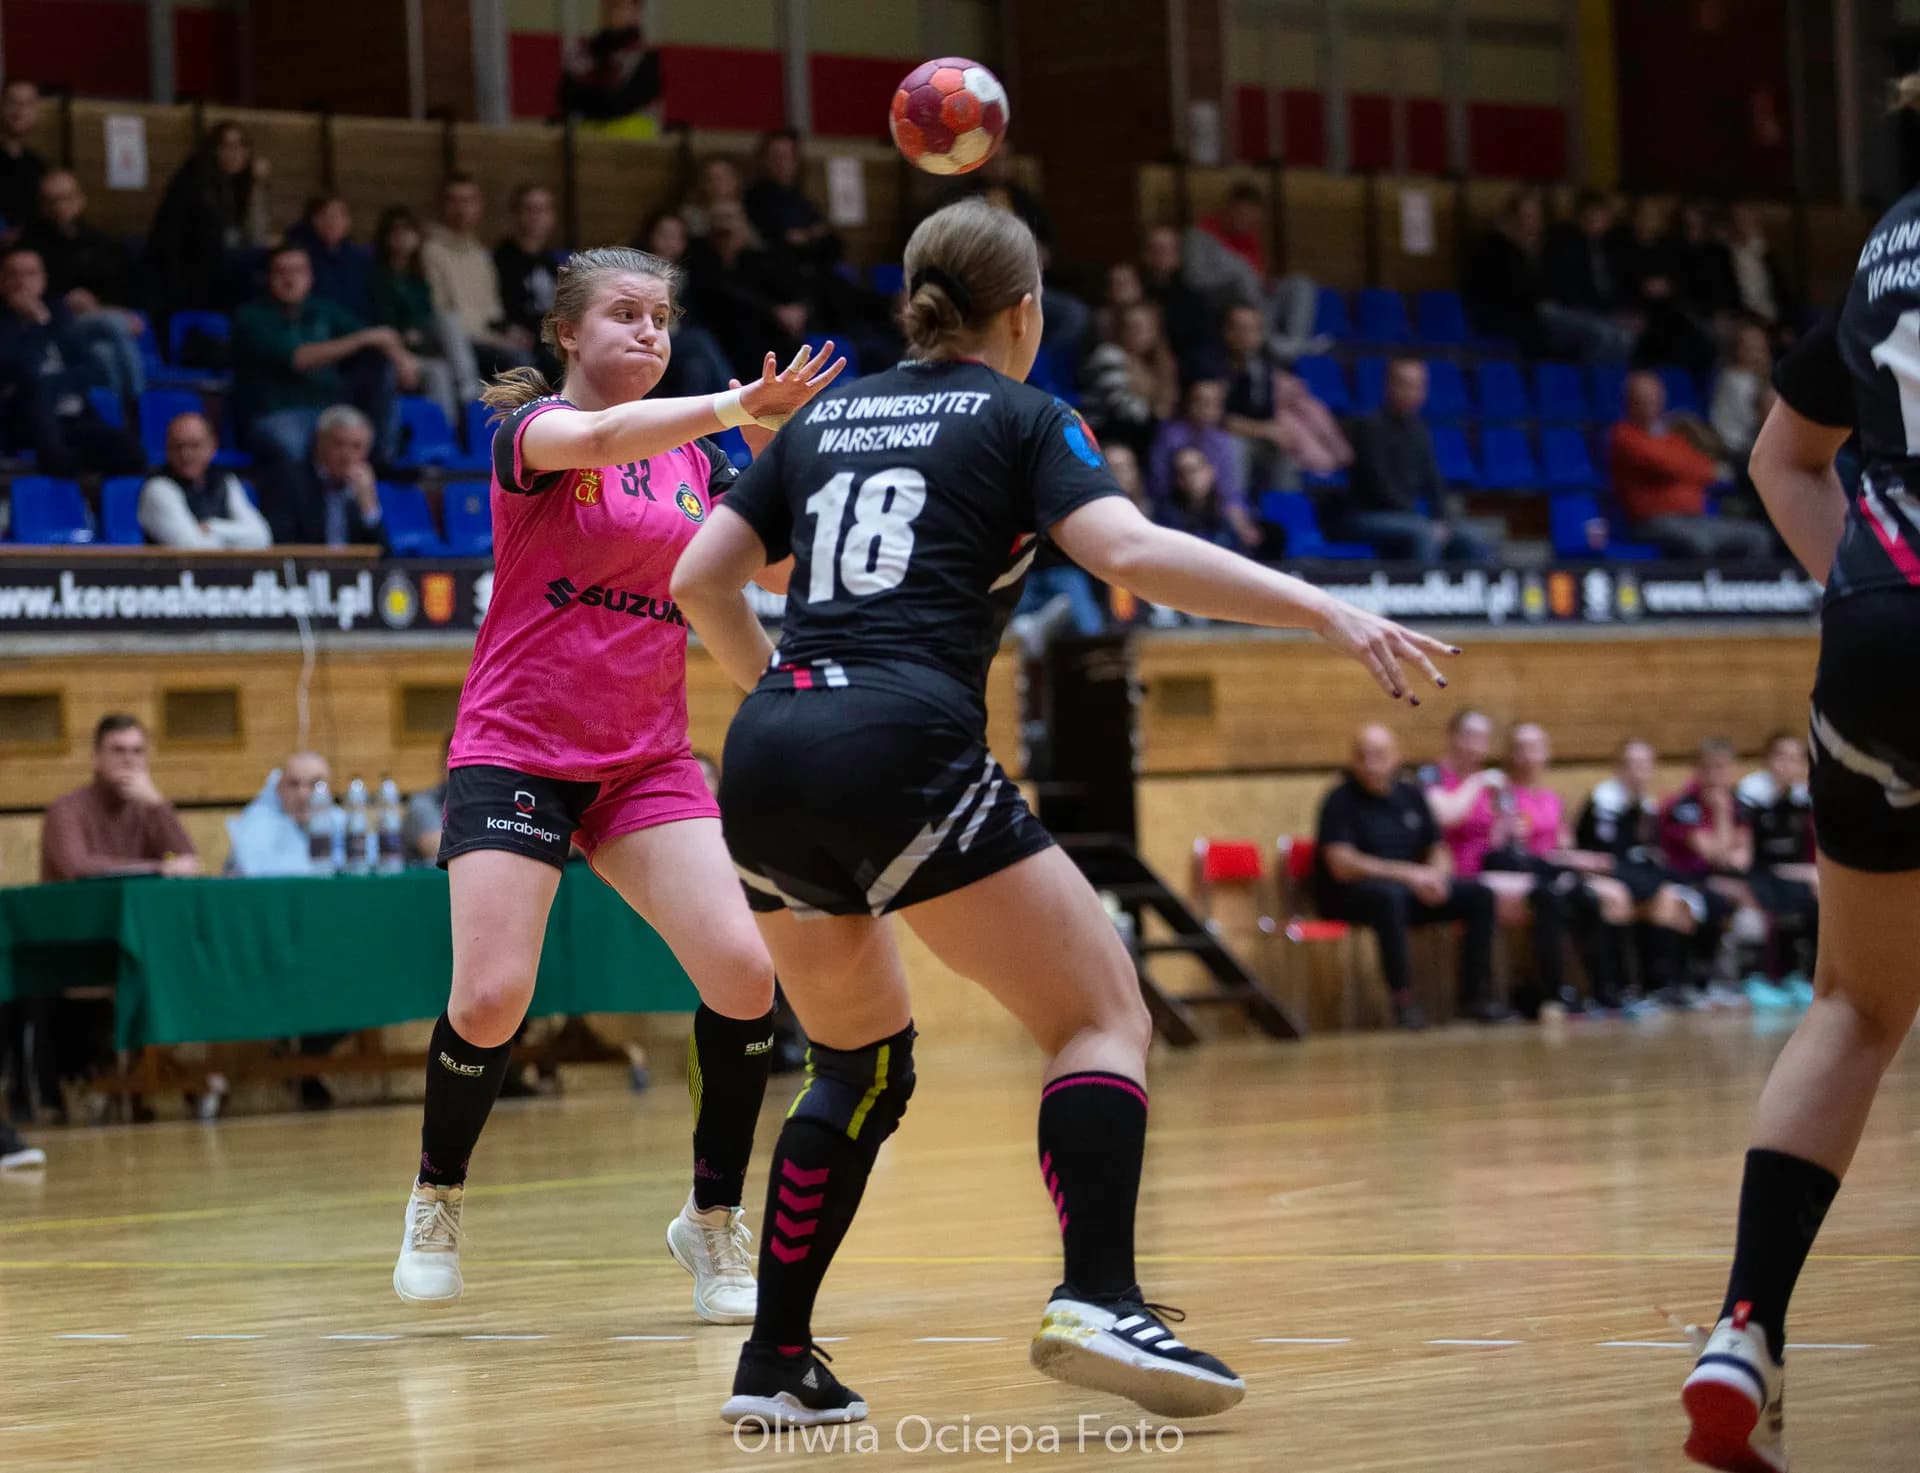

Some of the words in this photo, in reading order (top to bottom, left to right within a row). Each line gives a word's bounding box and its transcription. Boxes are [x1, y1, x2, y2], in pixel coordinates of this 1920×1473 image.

[805, 398, 848, 425] AZS
[846, 392, 991, 420] UNIWERSYTET
[818, 421, 940, 454] WARSZWSKI
[805, 467, 927, 604] 18
[487, 816, 552, 843] karabela
[440, 1050, 486, 1073] SELECT
